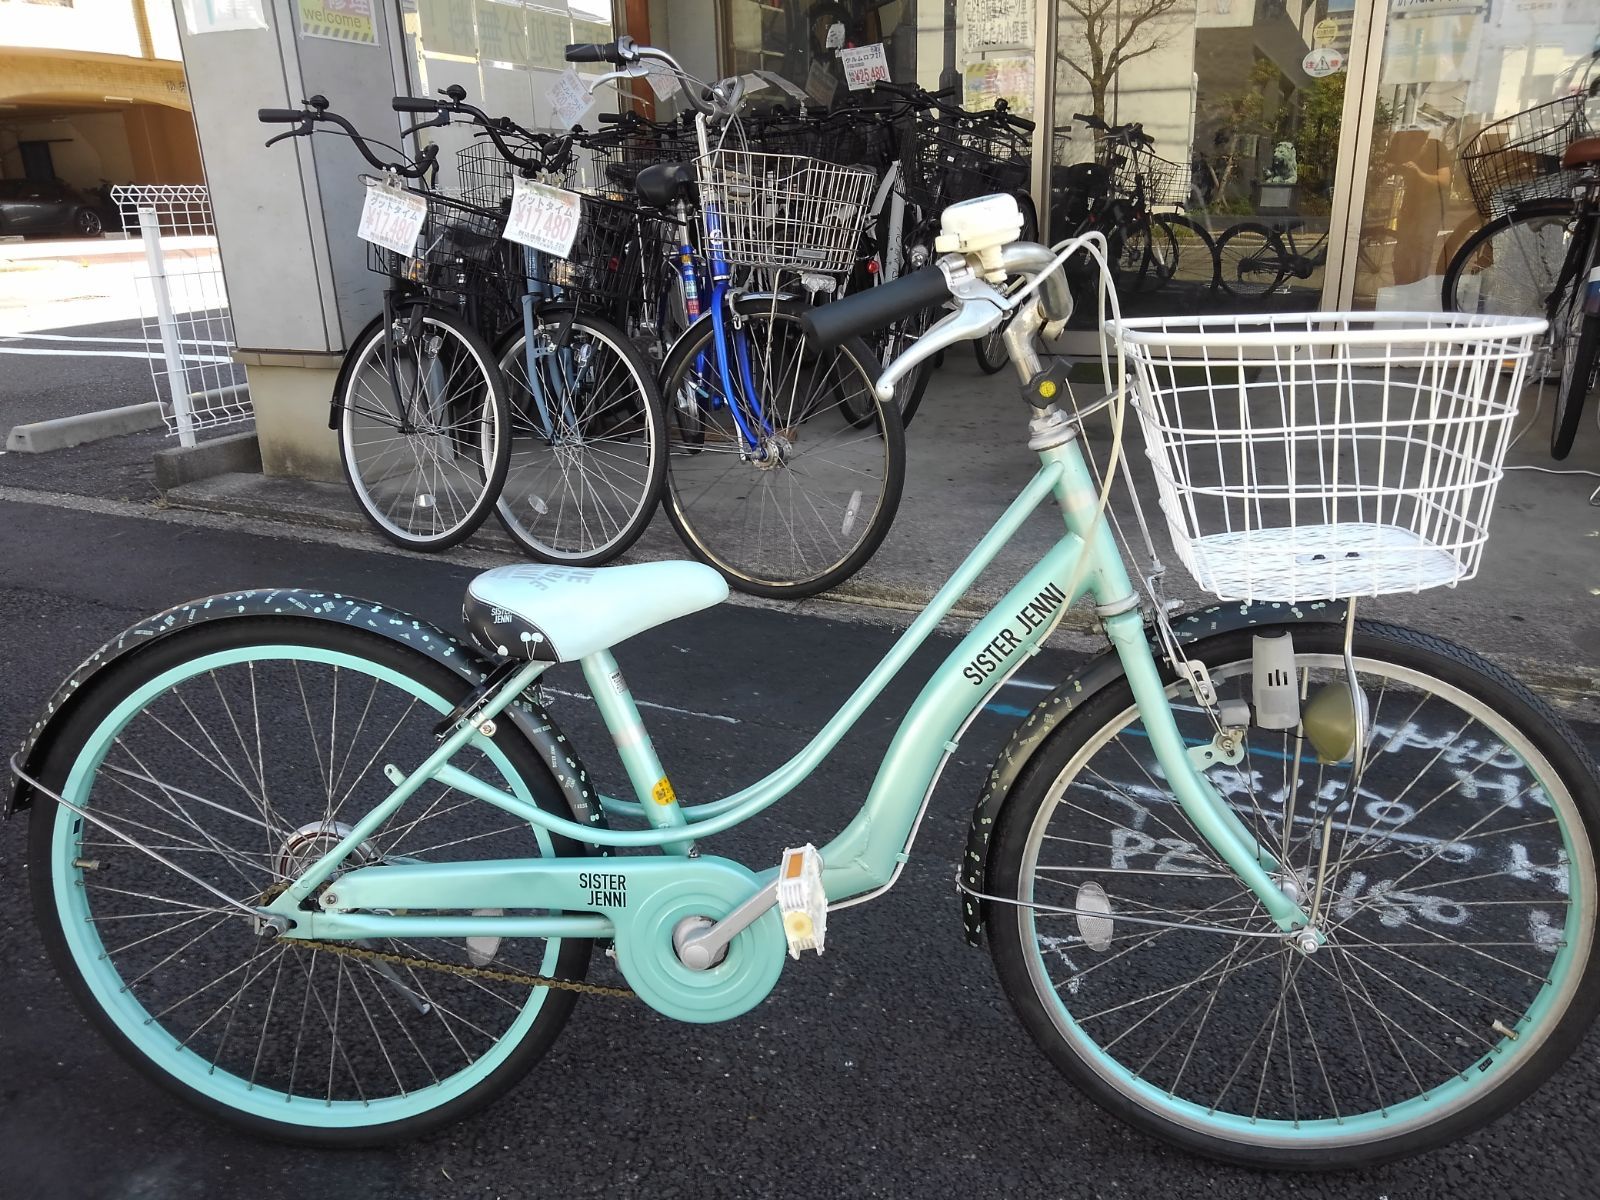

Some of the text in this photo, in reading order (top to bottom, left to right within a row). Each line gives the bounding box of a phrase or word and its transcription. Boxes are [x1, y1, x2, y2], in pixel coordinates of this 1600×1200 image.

[303, 7, 361, 28] welcome
[493, 614, 512, 624] JENNI
[963, 582, 1067, 686] SISTER JENNI
[579, 873, 626, 890] SISTER
[587, 890, 626, 907] JENNI
